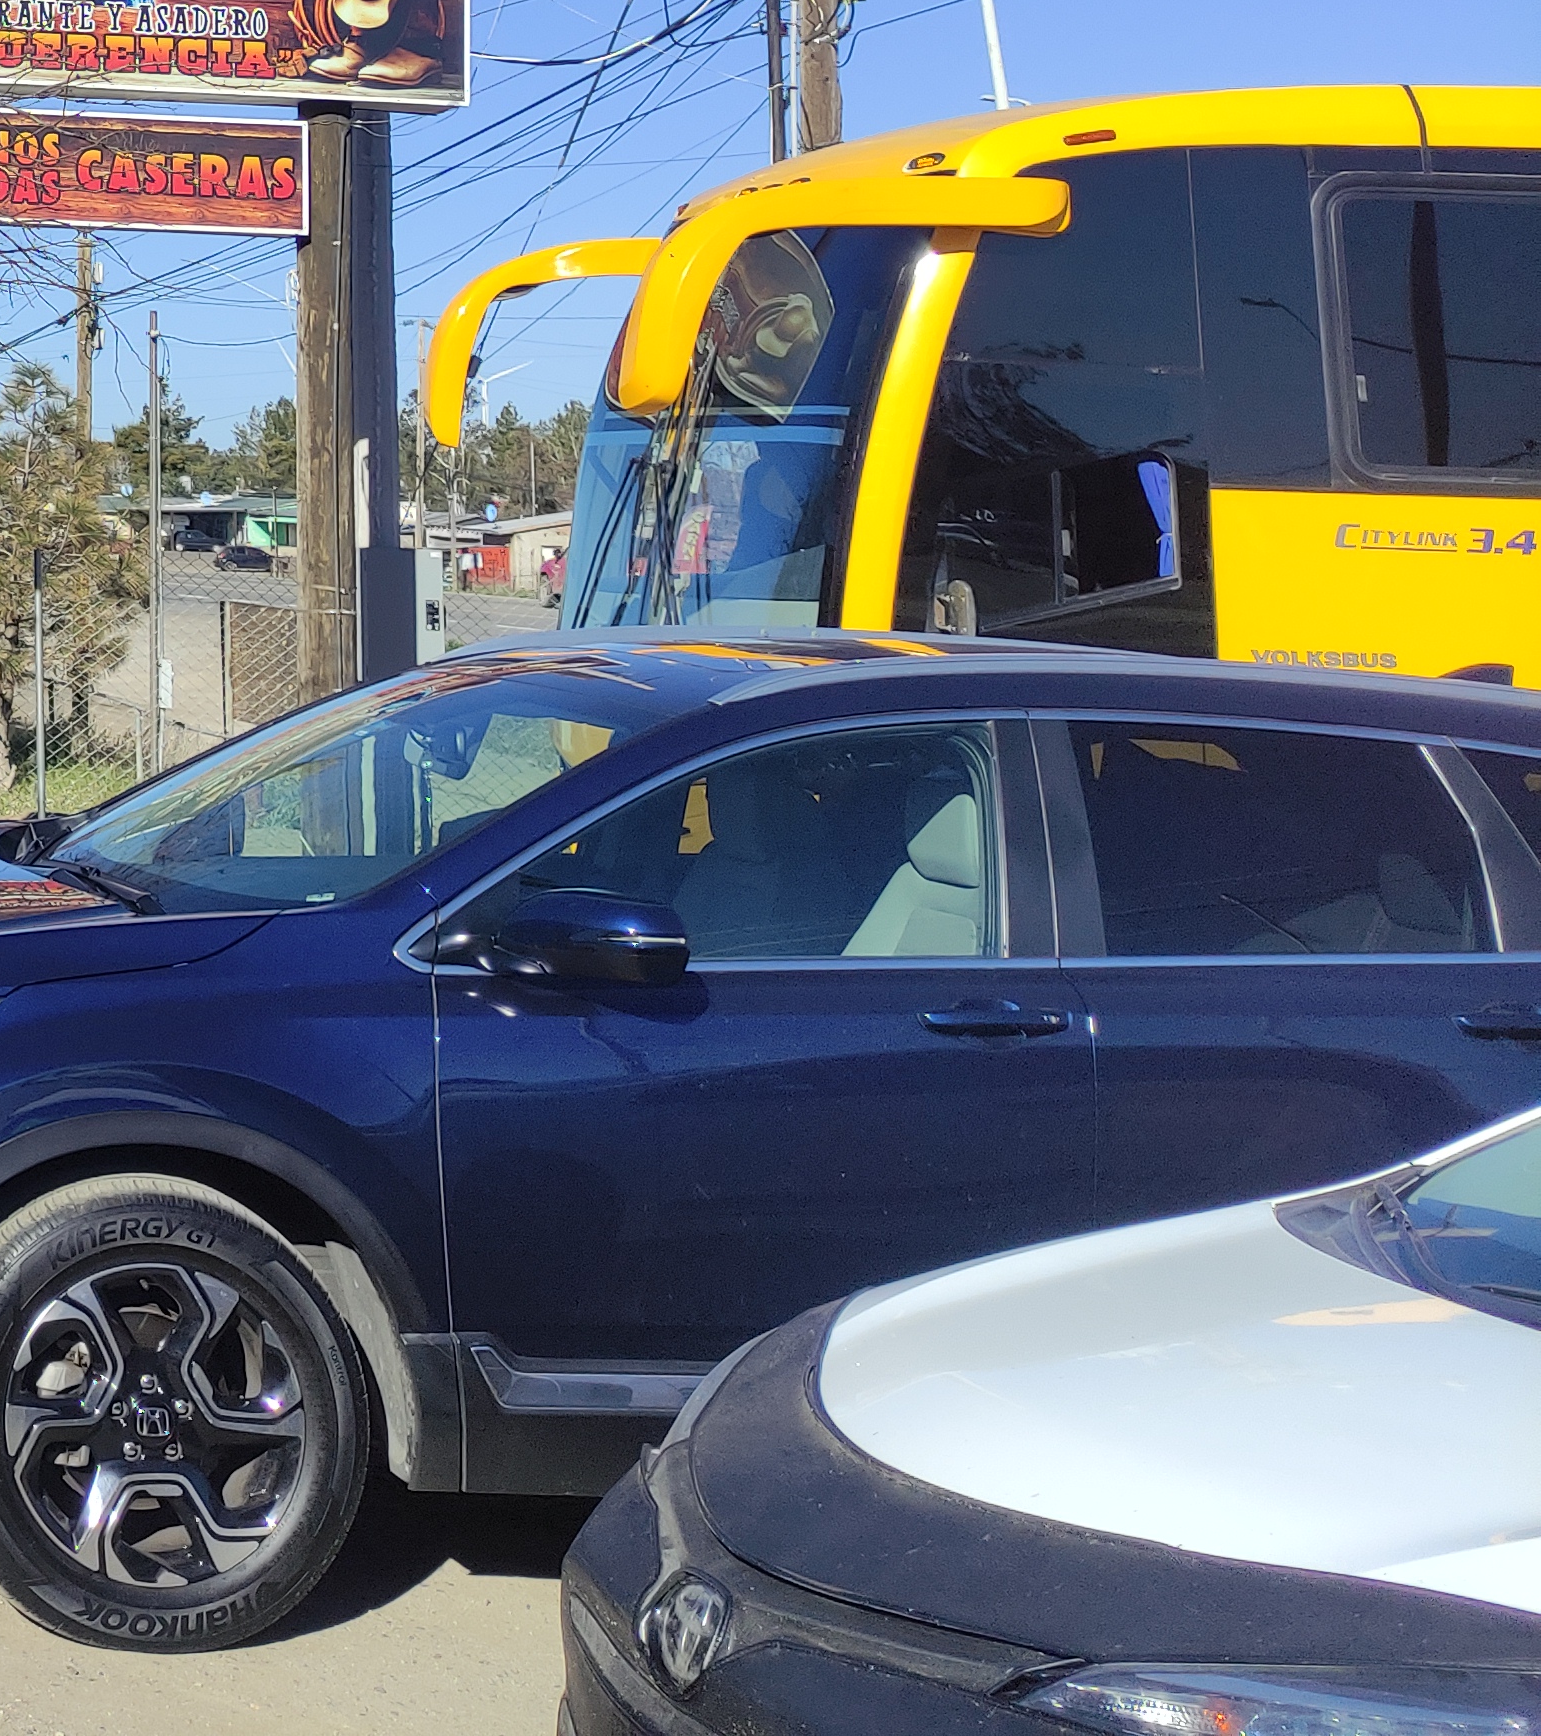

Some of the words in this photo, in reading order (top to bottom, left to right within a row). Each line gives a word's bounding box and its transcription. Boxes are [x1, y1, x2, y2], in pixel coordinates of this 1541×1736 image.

[105, 2, 125, 33] Y
[134, 3, 269, 40] ASADERO
[75, 148, 298, 200] CASERAS
[1467, 528, 1537, 555] 3.4
[1251, 649, 1398, 668] VOLKSBUS
[328, 1345, 348, 1386] Kontrol
